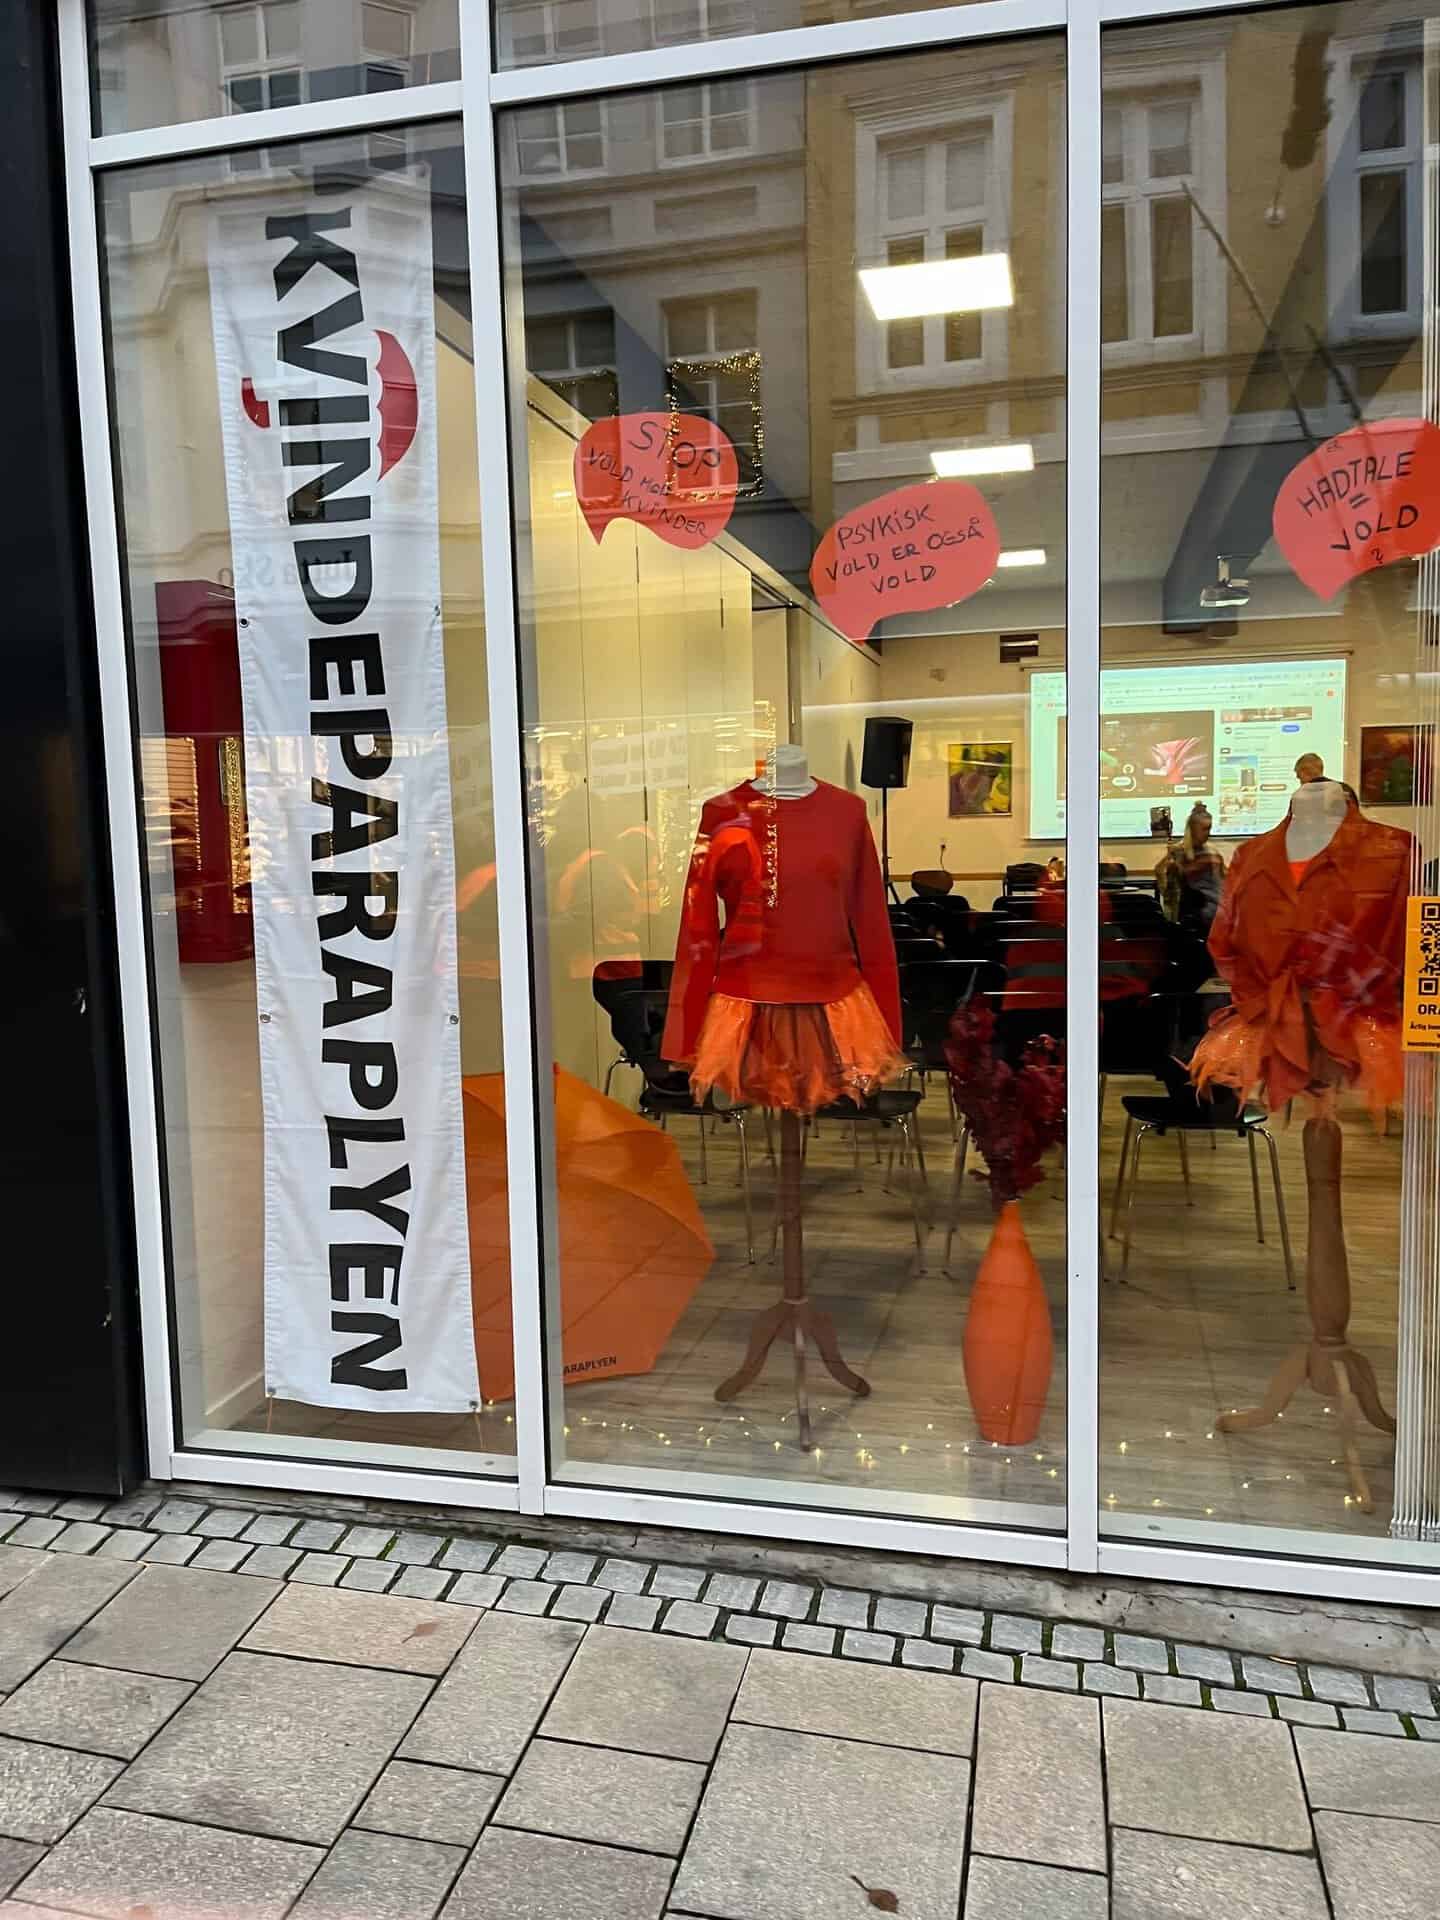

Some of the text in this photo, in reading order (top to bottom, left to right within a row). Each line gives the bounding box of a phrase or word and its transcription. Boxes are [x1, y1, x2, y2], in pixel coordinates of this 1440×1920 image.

[586, 447, 633, 482] VOLD
[628, 420, 721, 477] STOP
[1298, 451, 1416, 517] HADTALE
[825, 517, 985, 582] VOLD ER OGSÅ
[1330, 504, 1419, 551] VOLD
[872, 564, 937, 593] VOLD
[264, 206, 412, 1392] KVINDEPARAPLYEN
[1418, 1003, 1440, 1016] OR
